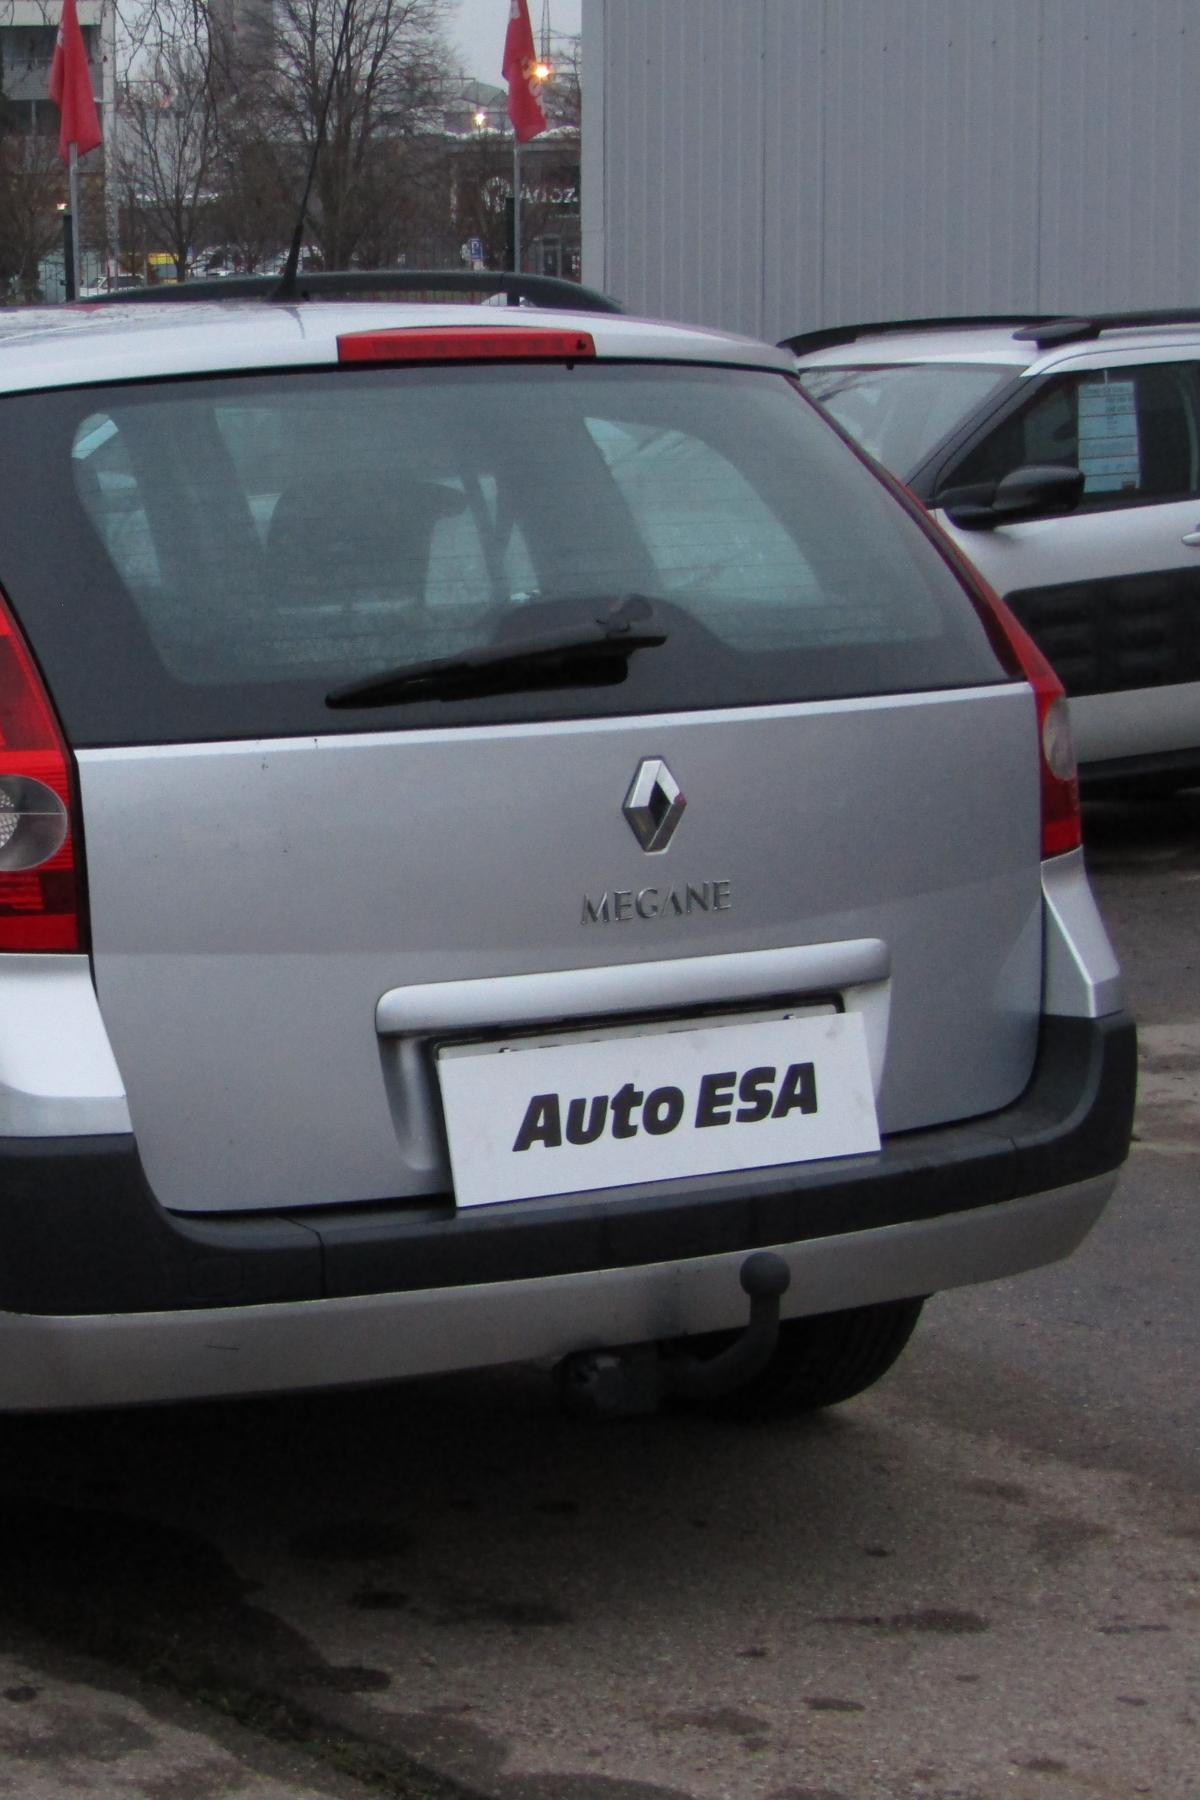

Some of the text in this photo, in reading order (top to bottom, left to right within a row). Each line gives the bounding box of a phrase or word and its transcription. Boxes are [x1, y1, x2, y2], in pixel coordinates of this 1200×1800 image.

[580, 879, 732, 926] MEGANE
[511, 1061, 818, 1152] Auto ESA
